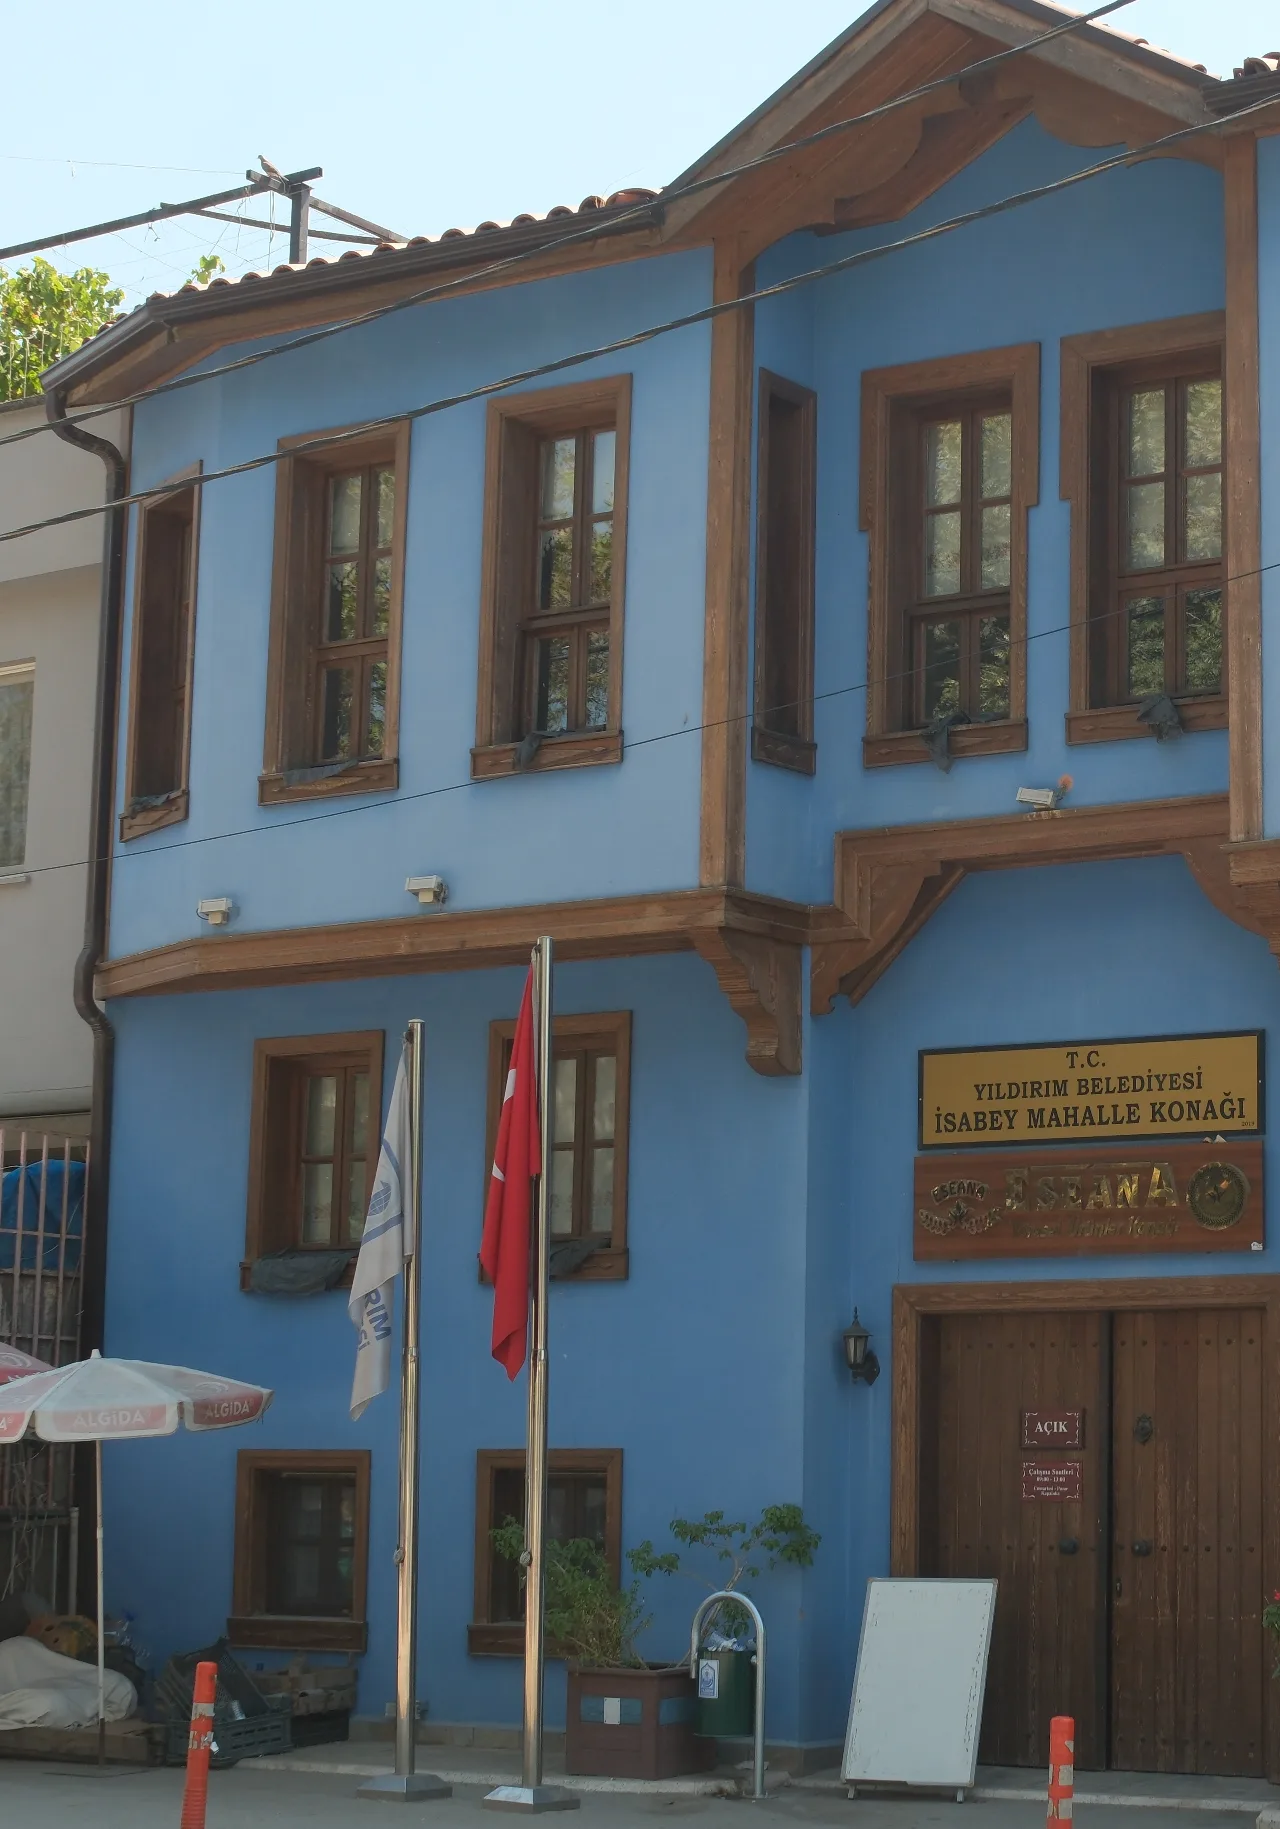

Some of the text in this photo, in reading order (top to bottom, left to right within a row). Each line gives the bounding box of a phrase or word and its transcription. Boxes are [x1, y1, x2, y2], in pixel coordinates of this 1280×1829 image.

[1066, 1050, 1107, 1069] T.C.
[974, 1065, 1203, 1101] YILDIRIM BELEDİYESİ
[934, 1091, 1246, 1135] İSABEY MAHALLE KONAĞI
[1034, 1421, 1068, 1435] AÇIK
